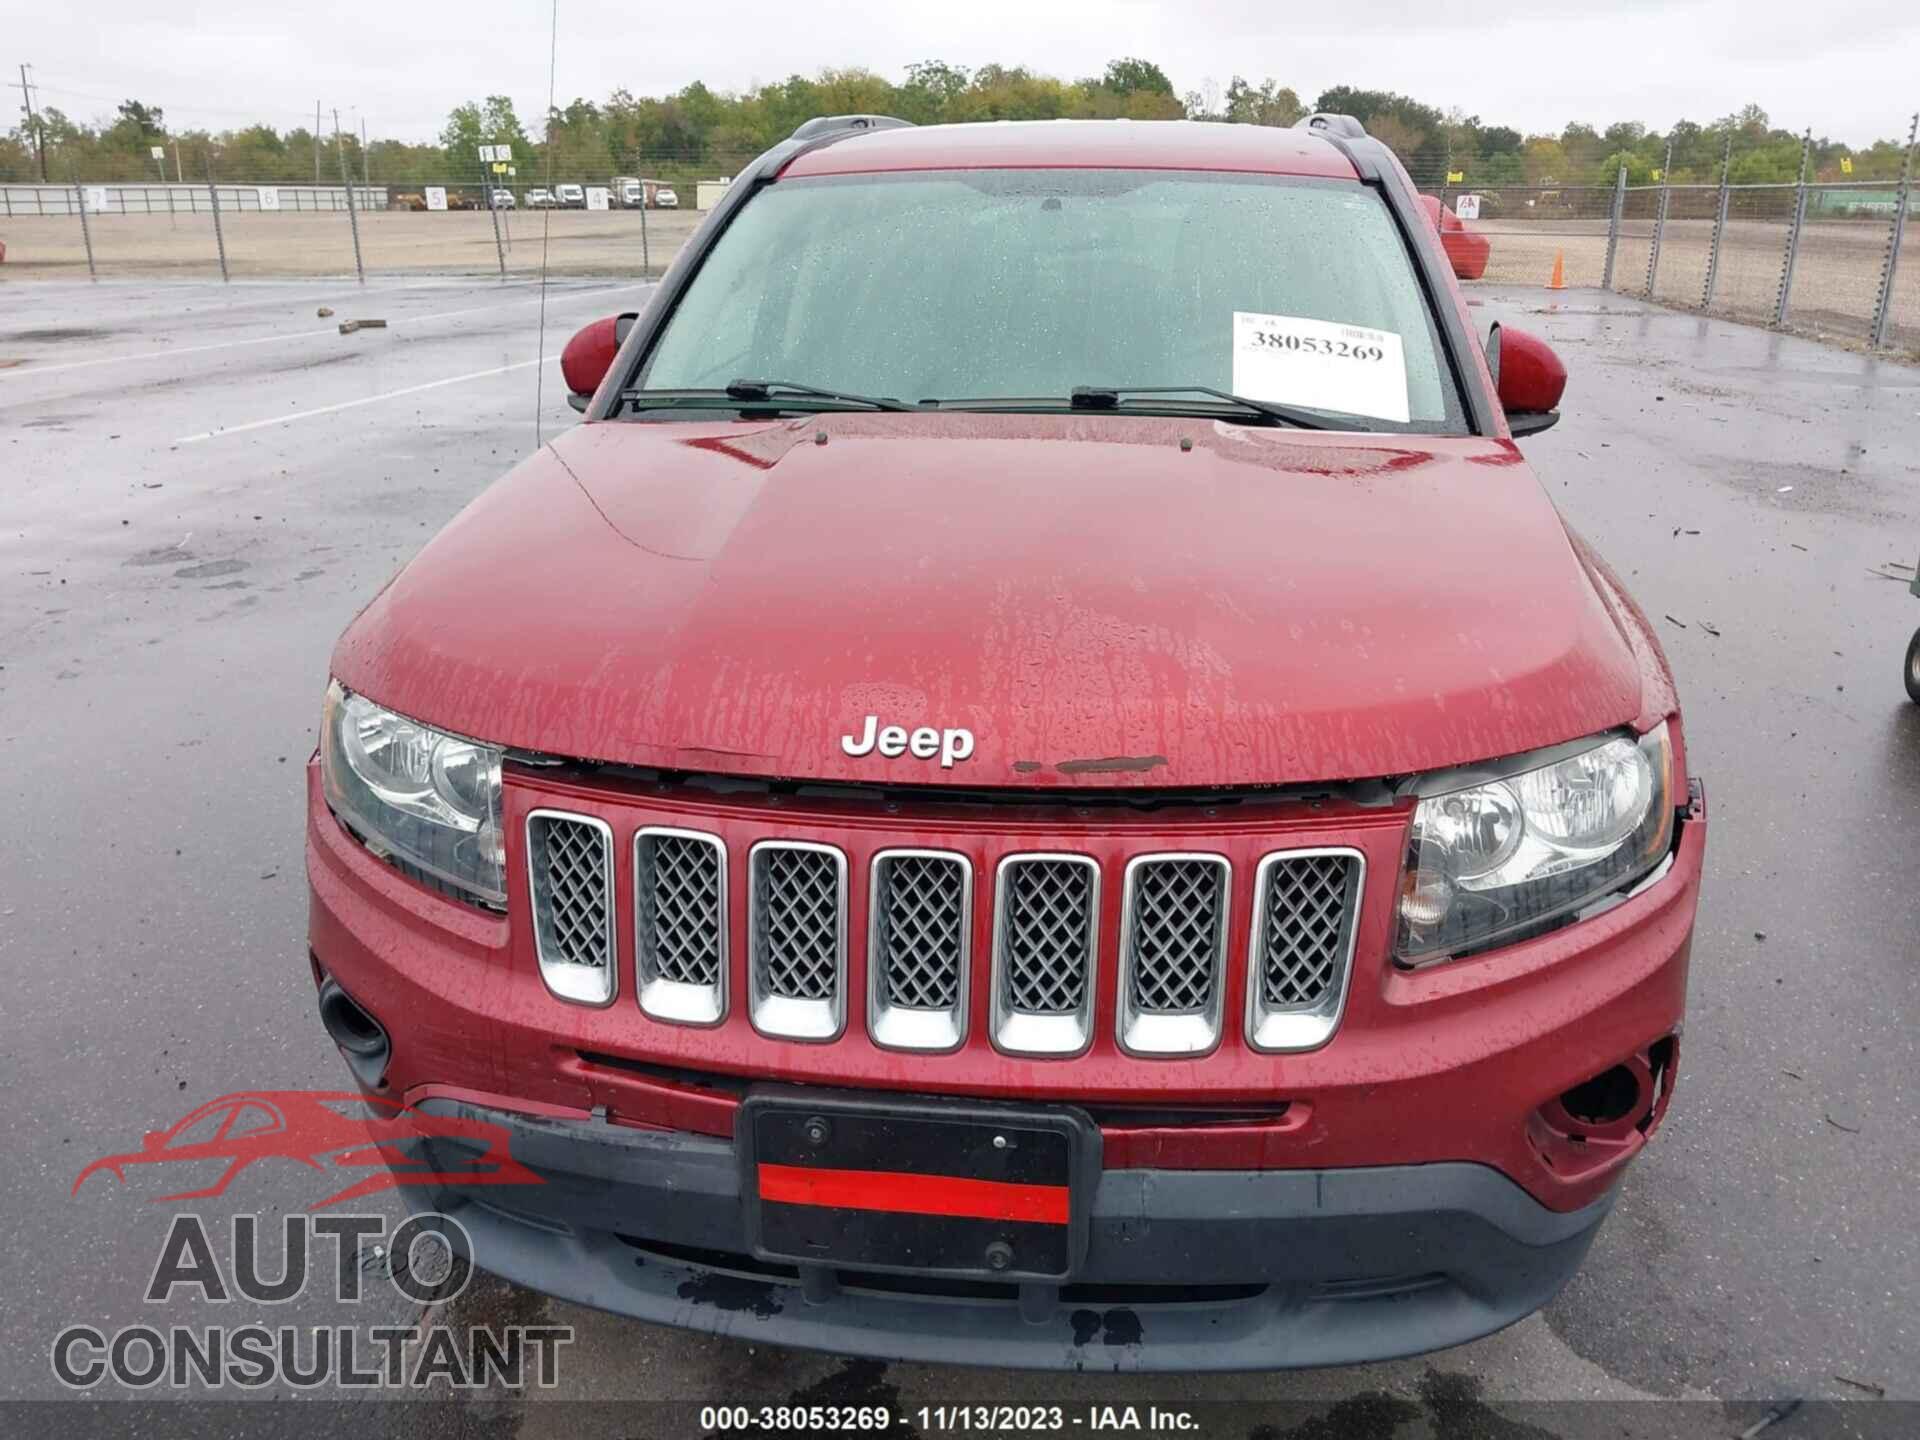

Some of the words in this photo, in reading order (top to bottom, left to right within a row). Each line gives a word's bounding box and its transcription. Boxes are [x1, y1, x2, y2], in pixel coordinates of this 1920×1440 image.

[264, 191, 273, 207] 6
[431, 191, 441, 206] 5
[1251, 331, 1384, 362] 38053269
[841, 716, 974, 767] Jeep
